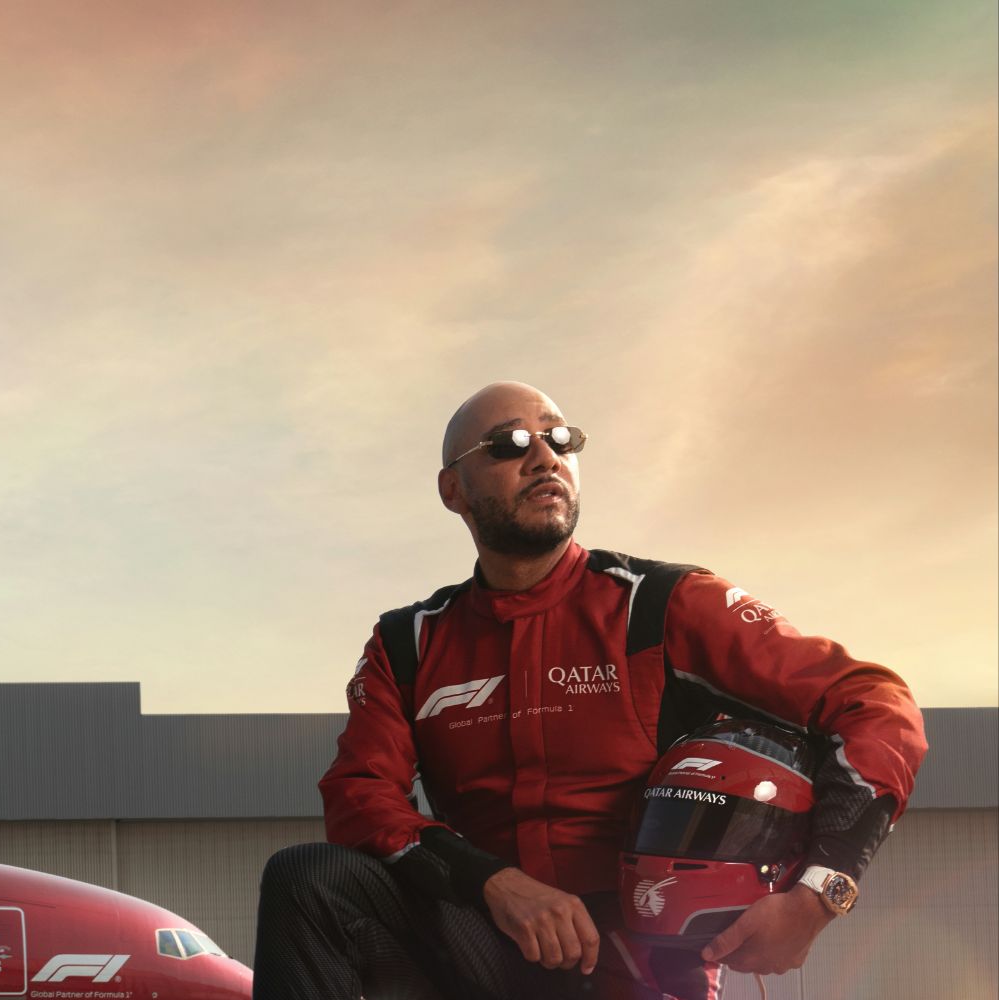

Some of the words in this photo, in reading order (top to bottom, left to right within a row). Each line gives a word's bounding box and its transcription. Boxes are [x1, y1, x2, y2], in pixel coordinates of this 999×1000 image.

[548, 664, 618, 686] QATAR
[415, 674, 506, 720] F1
[565, 681, 620, 695] AIRWAYS
[449, 719, 473, 729] Global
[512, 711, 522, 719] of
[527, 706, 562, 715] Formula
[568, 704, 573, 712] 1
[671, 757, 723, 771] F1
[644, 787, 673, 798] QATAR
[673, 789, 727, 805] AIRWAYS
[31, 954, 131, 982] F1
[30, 990, 54, 998] Global
